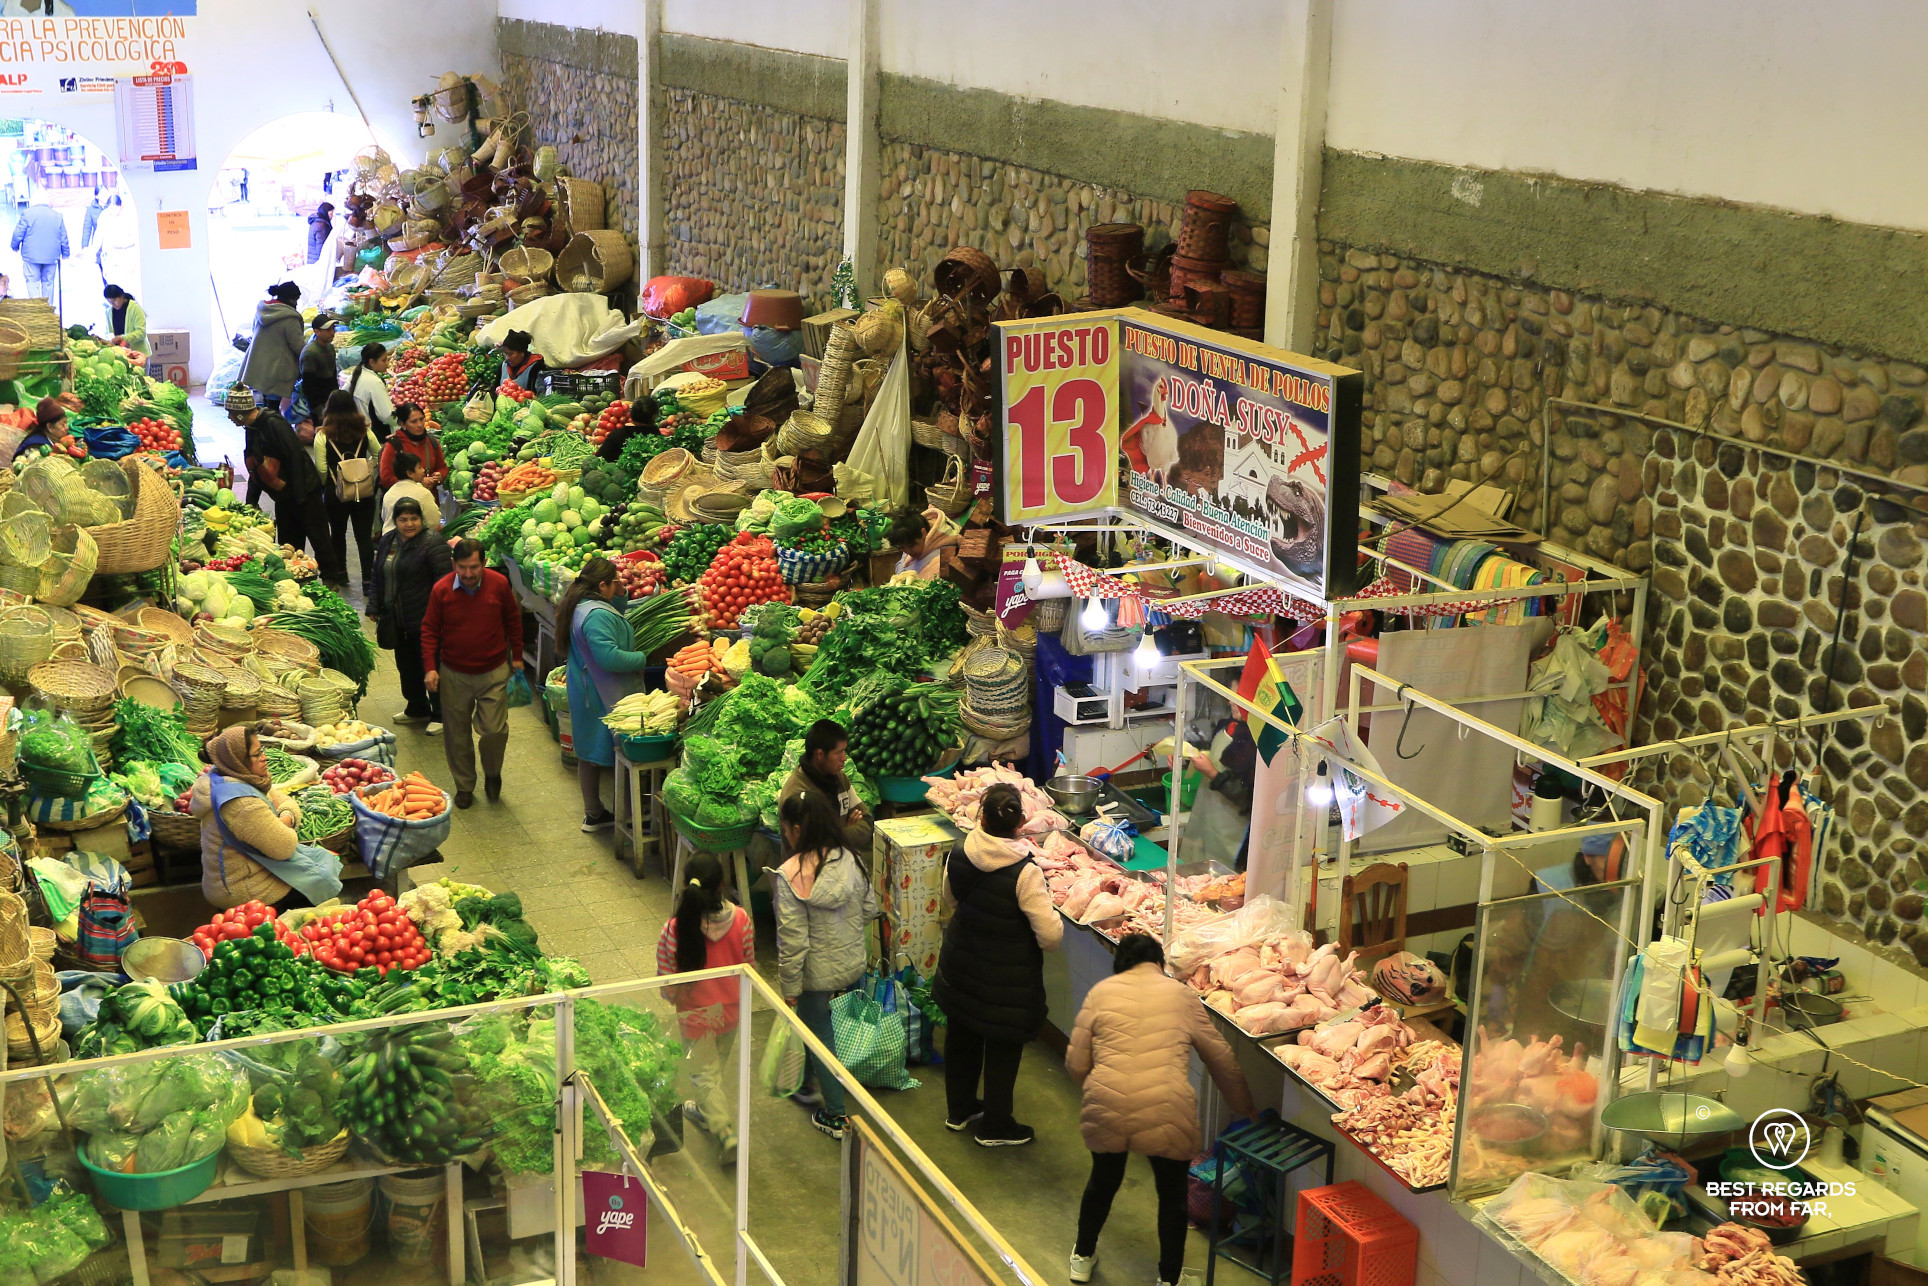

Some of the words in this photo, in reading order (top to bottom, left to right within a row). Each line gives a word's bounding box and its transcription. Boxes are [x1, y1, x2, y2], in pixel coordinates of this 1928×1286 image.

[31, 19, 57, 40] LA
[64, 11, 186, 40] PREVENCIÓN
[40, 37, 176, 62] PSICOLÓGICA
[1006, 326, 1109, 375] PUESTO
[1125, 326, 1177, 364] PUESTO
[1179, 341, 1198, 371] DE
[1199, 347, 1247, 387] VENTA
[1249, 363, 1270, 394] DE
[1272, 370, 1330, 414] POLLOS
[1171, 375, 1232, 428] DOÑA
[1236, 396, 1291, 448] SUSY
[1008, 378, 1107, 509] 13
[1129, 469, 1160, 497] Higiene
[1165, 484, 1197, 512] Calidad
[1202, 500, 1230, 526] Buena
[1230, 511, 1270, 543] Atención
[1183, 511, 1234, 547] Bienvenidos
[1235, 536, 1242, 551] a
[1243, 536, 1271, 562] Sucre
[596, 1210, 634, 1235] yape
